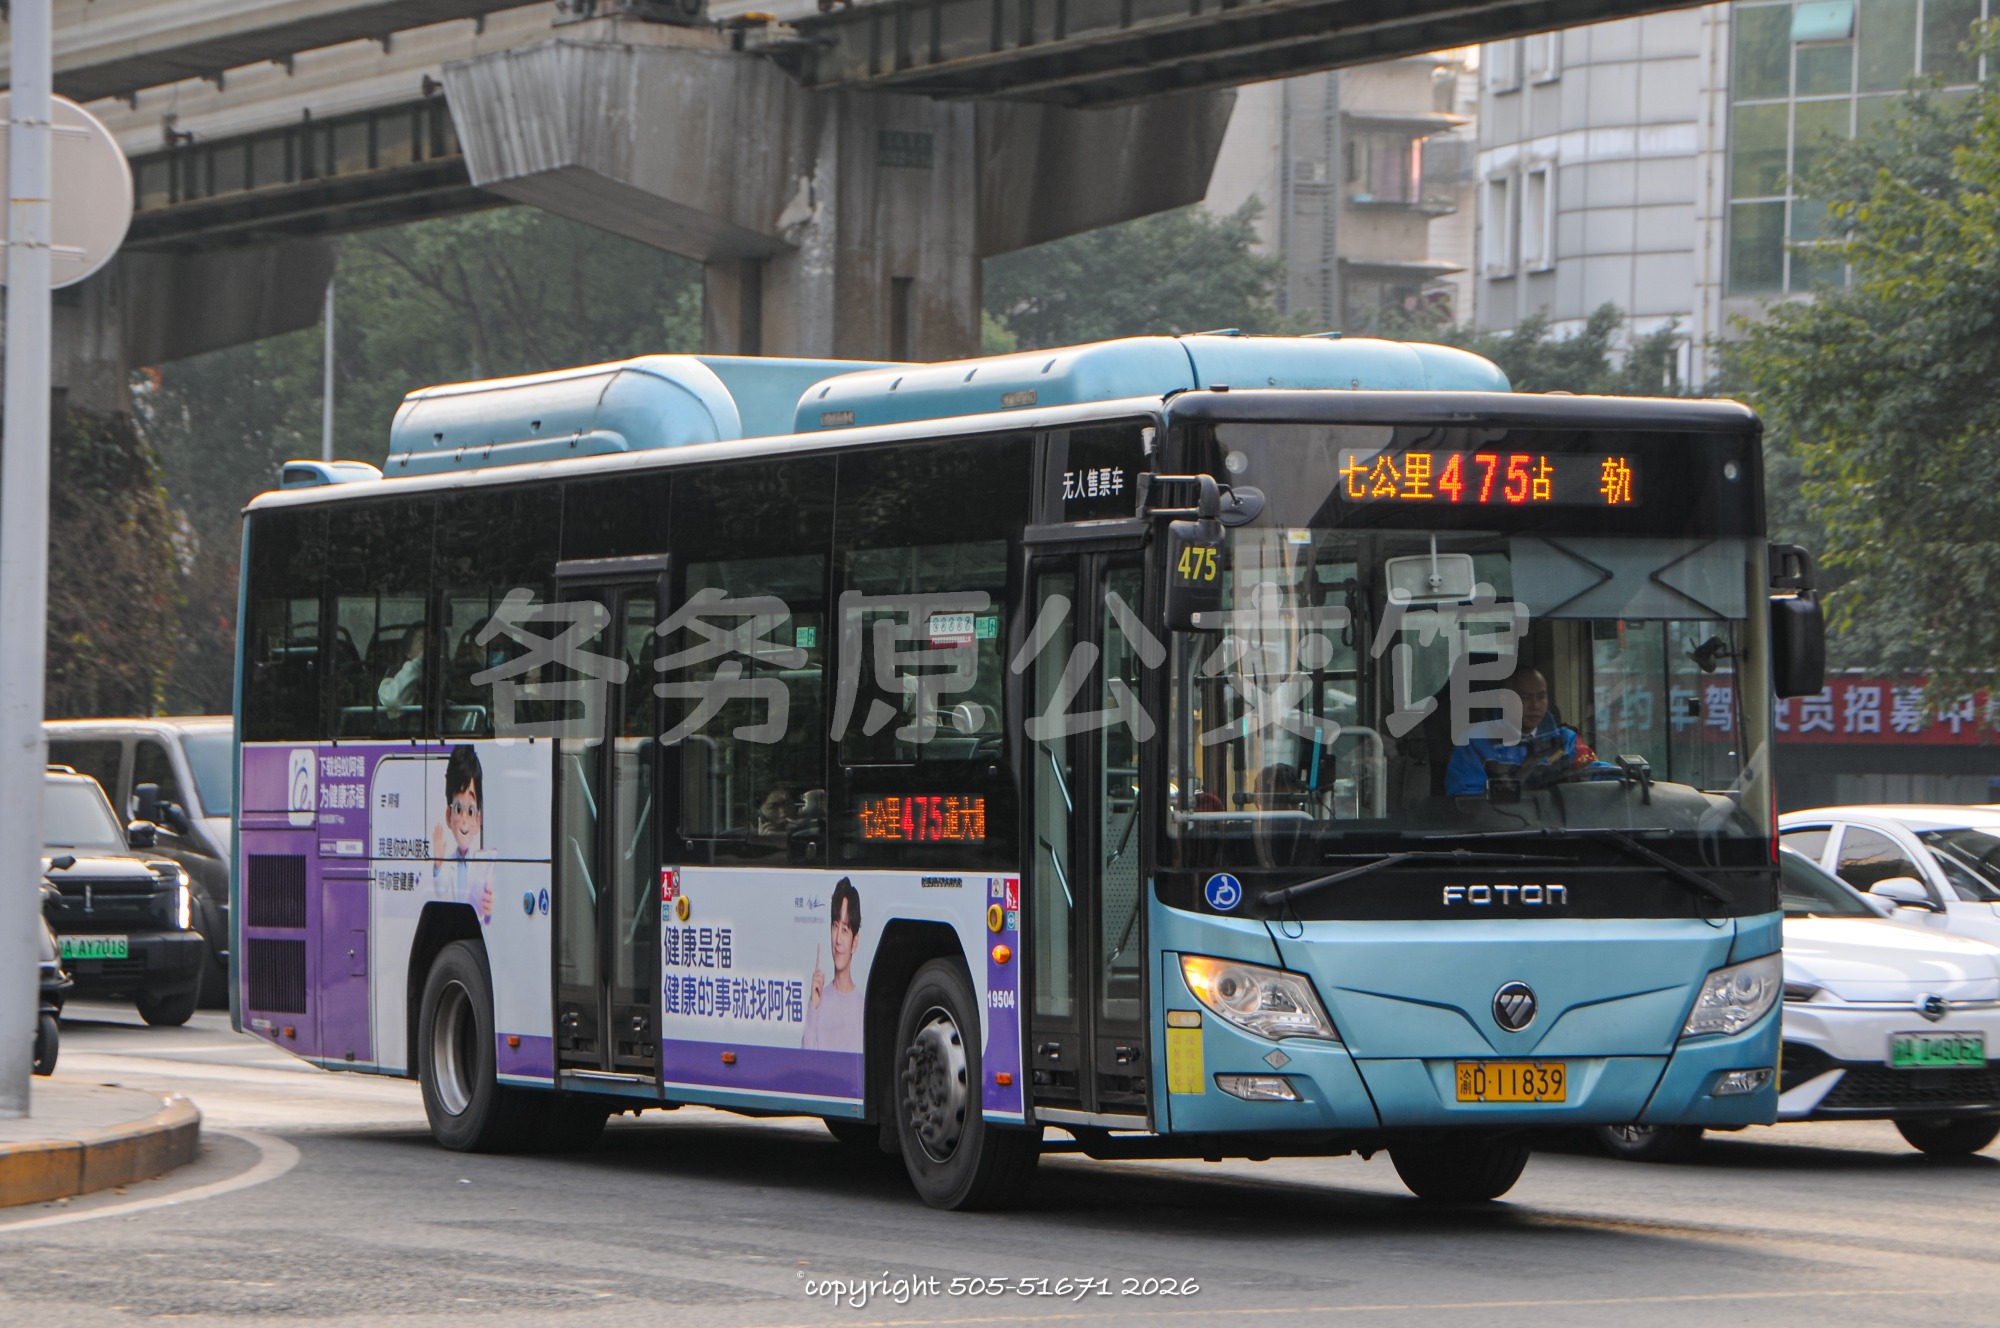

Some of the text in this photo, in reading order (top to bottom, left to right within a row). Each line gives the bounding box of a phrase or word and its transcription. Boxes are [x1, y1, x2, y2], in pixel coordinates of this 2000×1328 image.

[1062, 466, 1124, 500] 无人售票车
[1177, 546, 1217, 581] 475
[1442, 884, 1568, 906] FOTON
[664, 925, 732, 969] 健康是福
[664, 974, 803, 1023] 健康的事就找阿福
[987, 990, 1015, 1009] 19504
